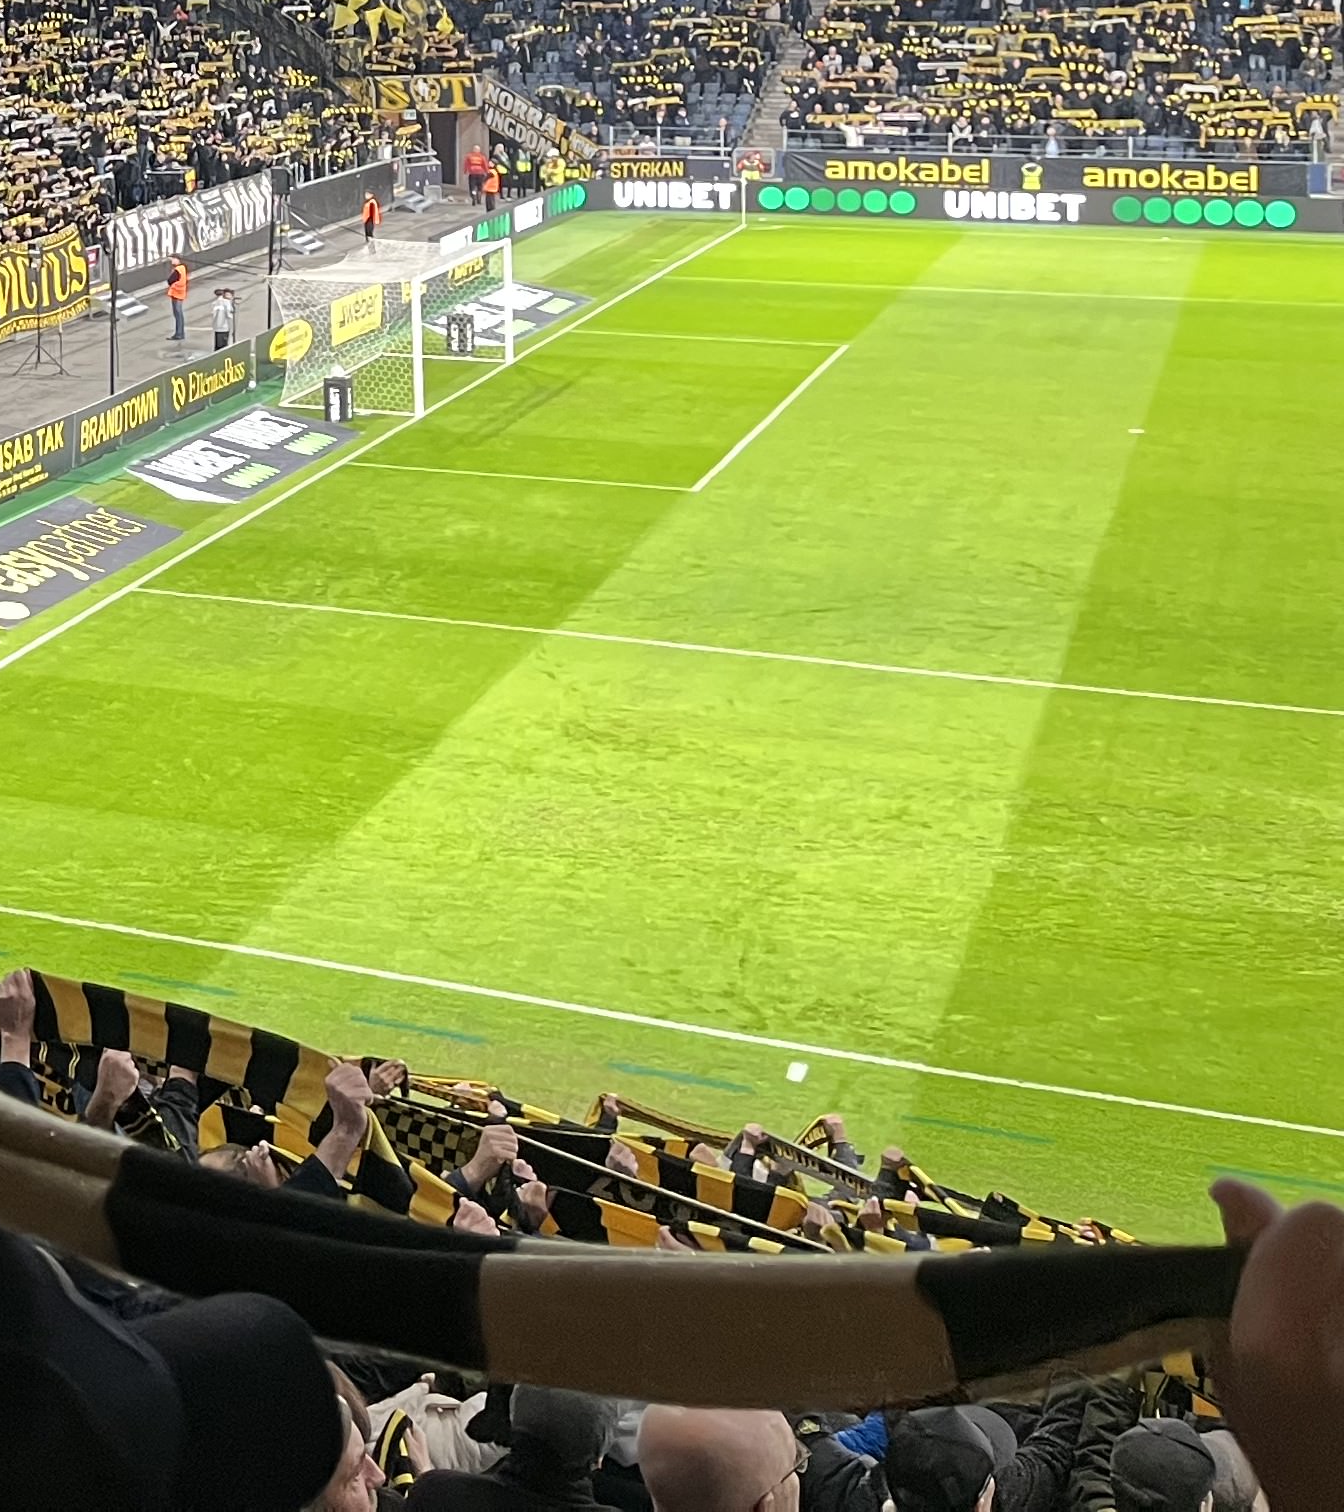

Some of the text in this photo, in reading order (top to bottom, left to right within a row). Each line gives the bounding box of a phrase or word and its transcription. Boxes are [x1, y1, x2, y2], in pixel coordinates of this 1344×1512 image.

[486, 81, 557, 139] NORRA
[611, 161, 684, 180] STYRKAN
[824, 156, 990, 185] amokabel
[1082, 163, 1259, 192] amokabel
[613, 181, 736, 210] UNIBET
[944, 190, 1086, 223] UNIBET
[80, 387, 160, 453] BRANDTOWN
[36, 421, 64, 453] TAK
